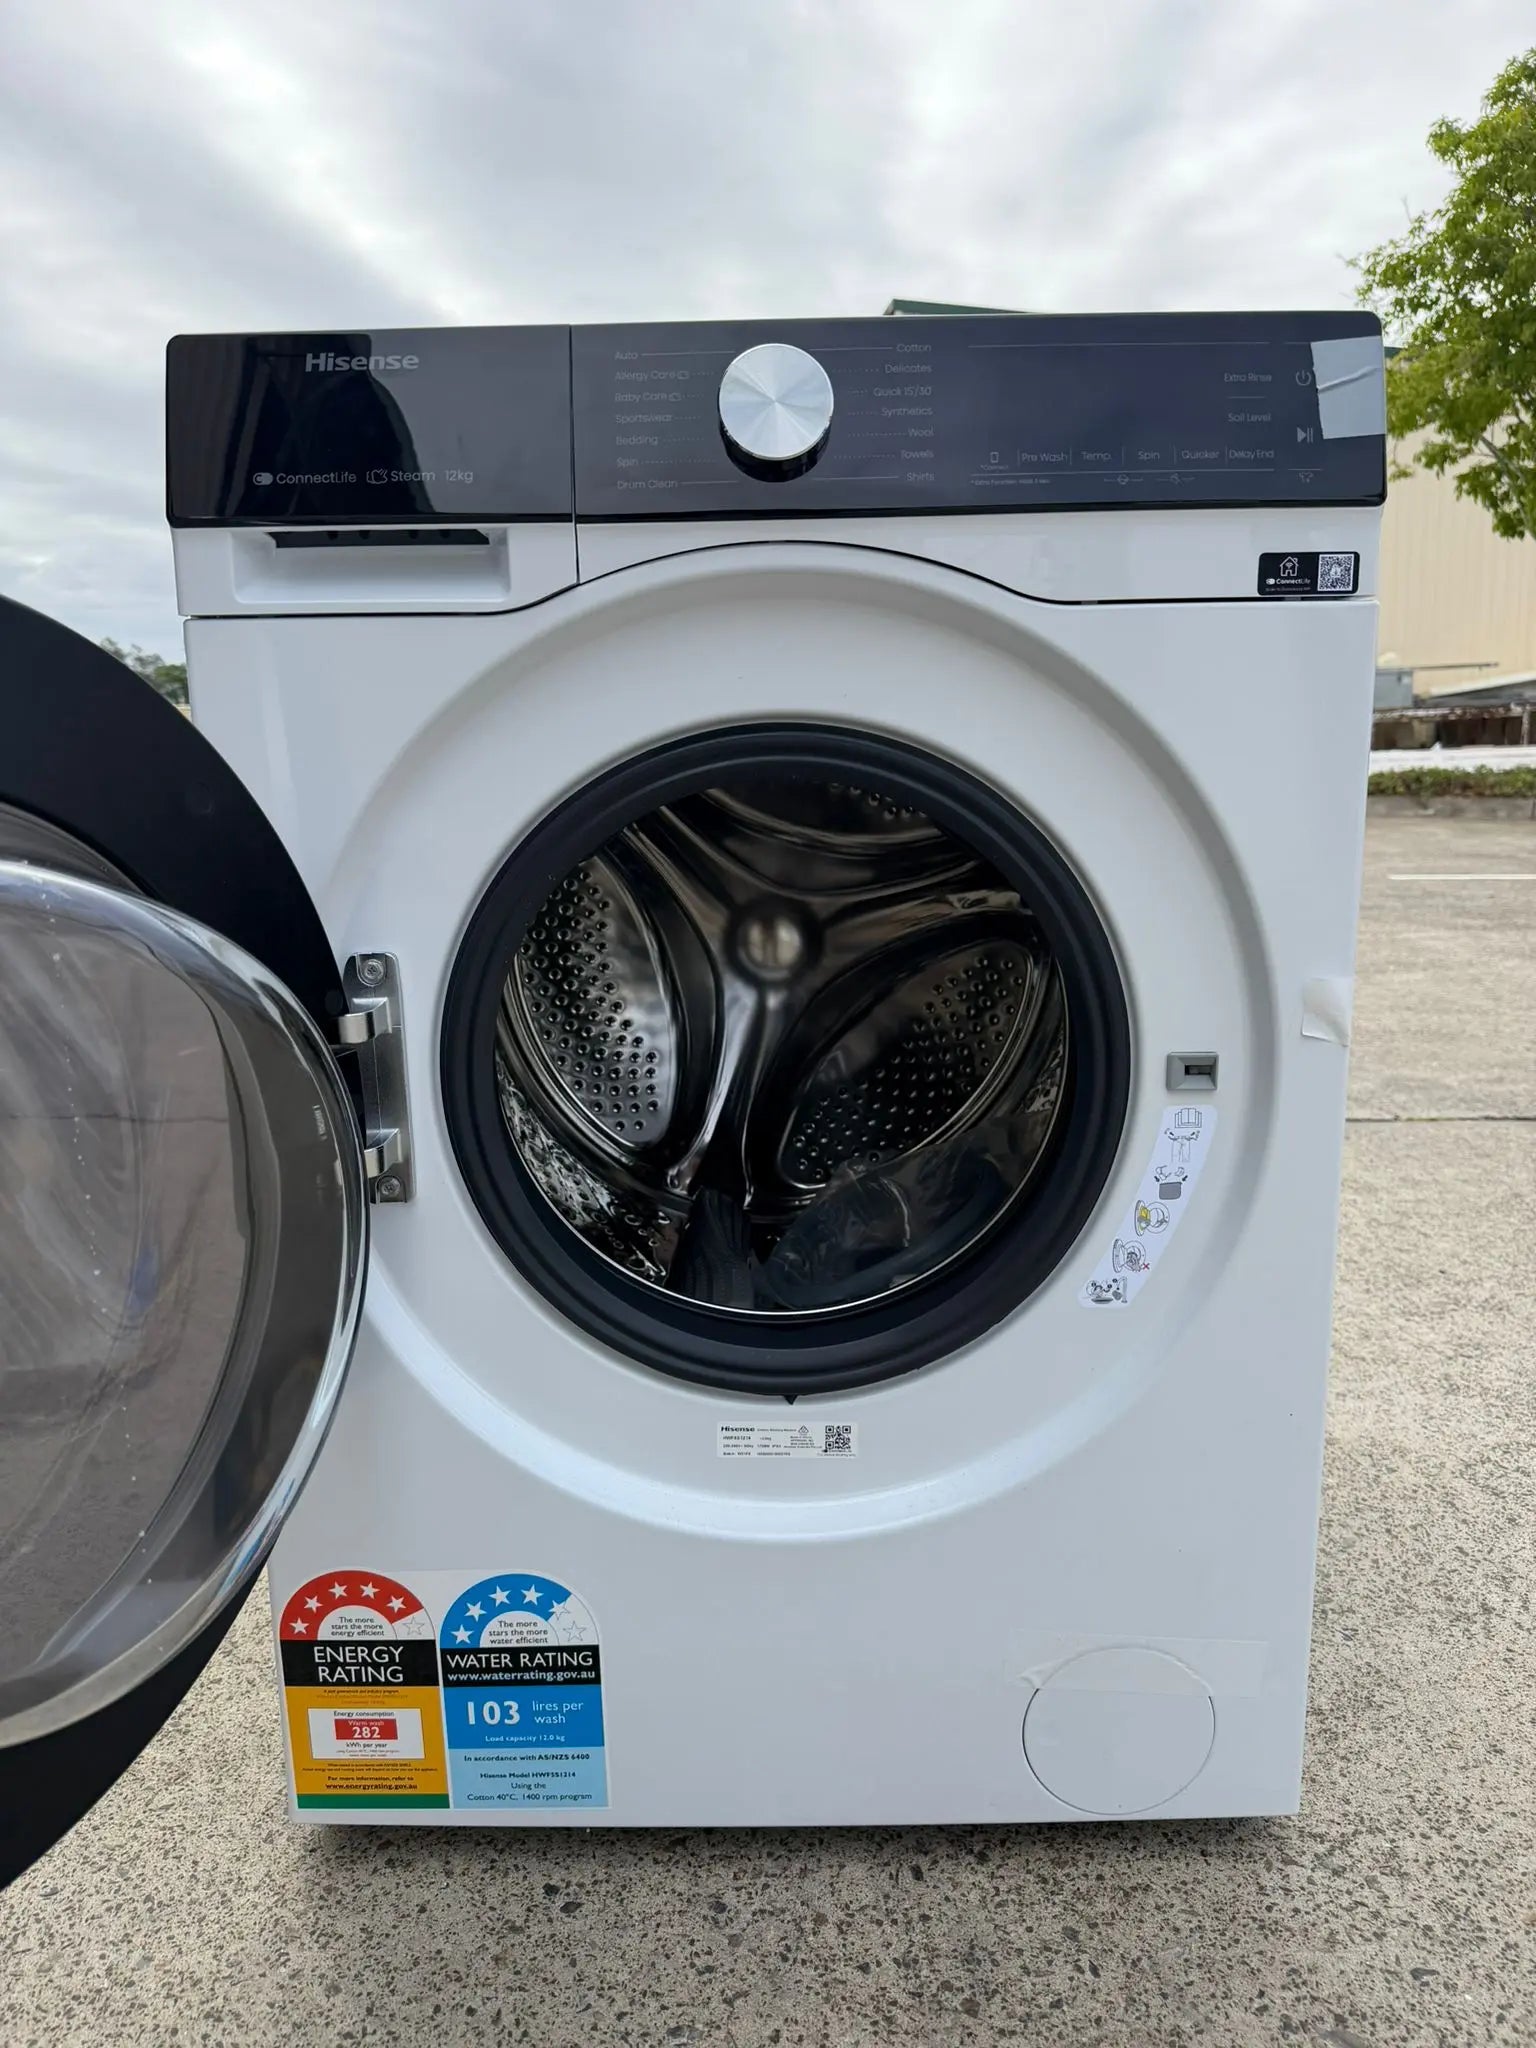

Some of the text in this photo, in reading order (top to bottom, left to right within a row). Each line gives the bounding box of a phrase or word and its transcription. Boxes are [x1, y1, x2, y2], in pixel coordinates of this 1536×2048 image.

[896, 343, 932, 352] Cotton
[615, 351, 639, 360] Auto
[305, 352, 420, 373] Hisense
[884, 363, 933, 373] Delicates
[1224, 372, 1273, 382] Extra Rinse
[903, 385, 932, 398] 15/30
[880, 407, 934, 418] Synthetics
[1228, 412, 1271, 422] Soil Level
[907, 424, 935, 437] Wool
[900, 449, 935, 459] Towels
[1039, 450, 1068, 462] Wash
[1138, 450, 1160, 461] Spin
[1229, 449, 1275, 461] Delay End
[616, 457, 639, 468] Spin
[276, 469, 474, 485] ConnectLife Steam 12kg
[906, 471, 936, 482] Shirts
[617, 480, 678, 490] Drum Clean
[339, 1616, 354, 1624] The
[313, 1646, 404, 1663] ENERGY
[446, 1651, 593, 1669] WATER RATING
[317, 1666, 404, 1683] RATING
[447, 1670, 596, 1682] www.waterrating.gov.au
[532, 1700, 584, 1713] lires per
[333, 1710, 354, 1718] Energy
[467, 1701, 521, 1725] 103
[534, 1714, 566, 1724] wash
[352, 1726, 381, 1738] 282
[537, 1753, 569, 1761] AS/NZS
[508, 1771, 530, 1779] Model
[511, 1782, 532, 1790] Using
[467, 1793, 495, 1801] Cotton
[522, 1792, 541, 1800] 1400
[560, 1793, 592, 1802] program
